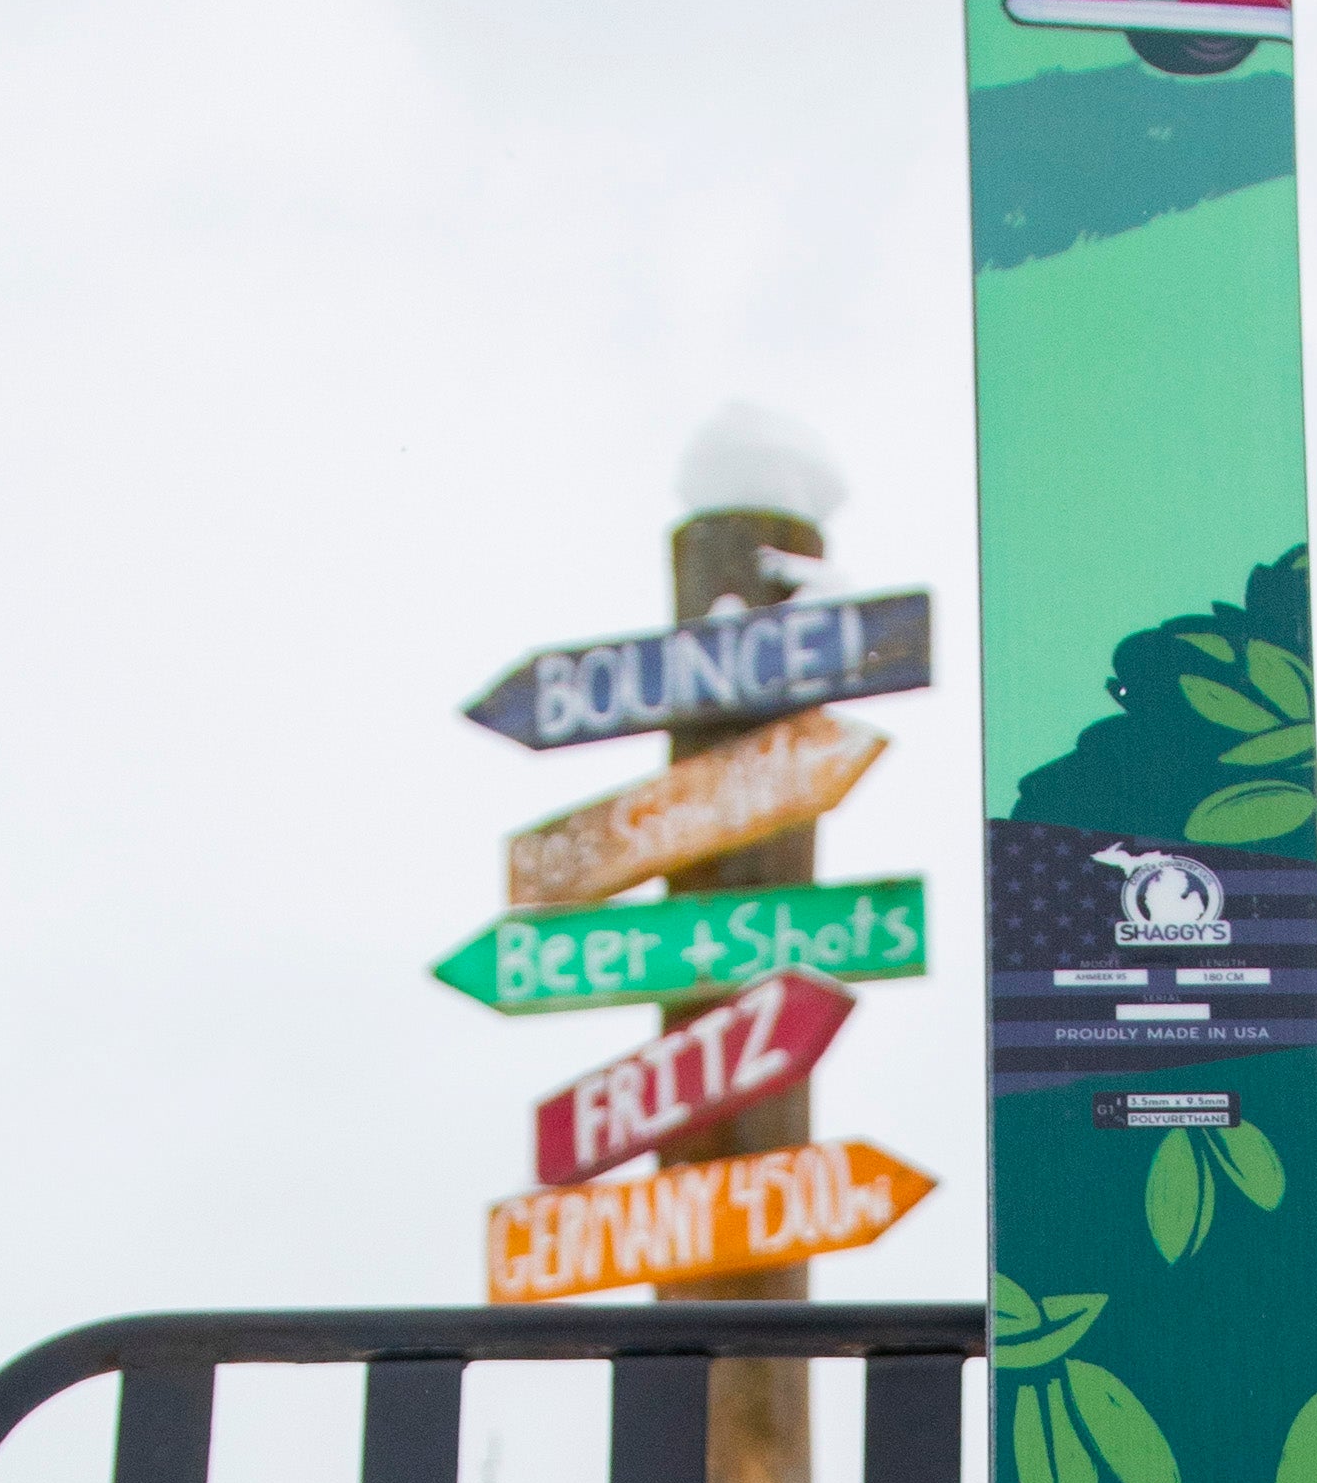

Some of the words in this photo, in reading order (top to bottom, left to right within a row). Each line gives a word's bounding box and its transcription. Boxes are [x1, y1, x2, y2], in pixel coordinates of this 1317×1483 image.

[1120, 923, 1227, 941] SHAGGY'S
[495, 920, 660, 1002] Beer
[727, 896, 922, 980] Shots
[1203, 972, 1223, 982] 180
[1226, 972, 1245, 982] CM
[1055, 1027, 1139, 1040] PROUDLY
[1147, 1027, 1200, 1039] MADE
[1208, 1027, 1226, 1039] IN
[1234, 1026, 1270, 1039] USA
[573, 986, 793, 1169] FRITZ
[1131, 1114, 1227, 1124] POLYURETHANE
